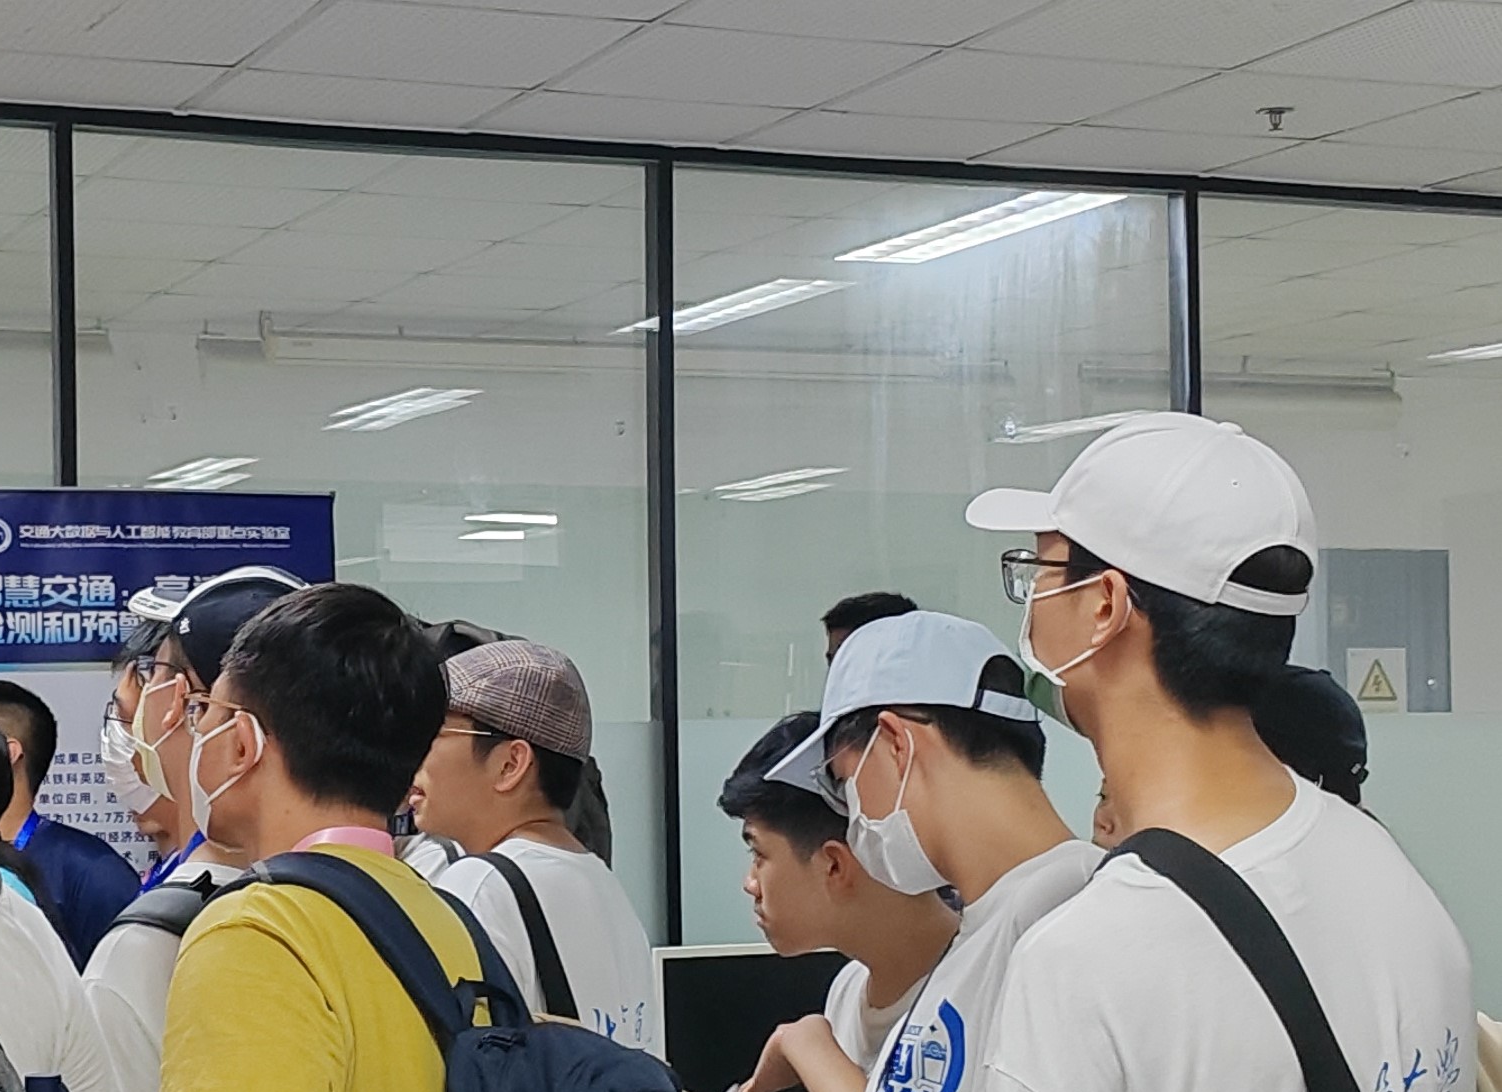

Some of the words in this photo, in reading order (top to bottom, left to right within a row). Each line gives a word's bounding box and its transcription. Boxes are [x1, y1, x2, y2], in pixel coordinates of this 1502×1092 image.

[19, 525, 291, 540] 交通大数据与人工智能教育部重点实验室
